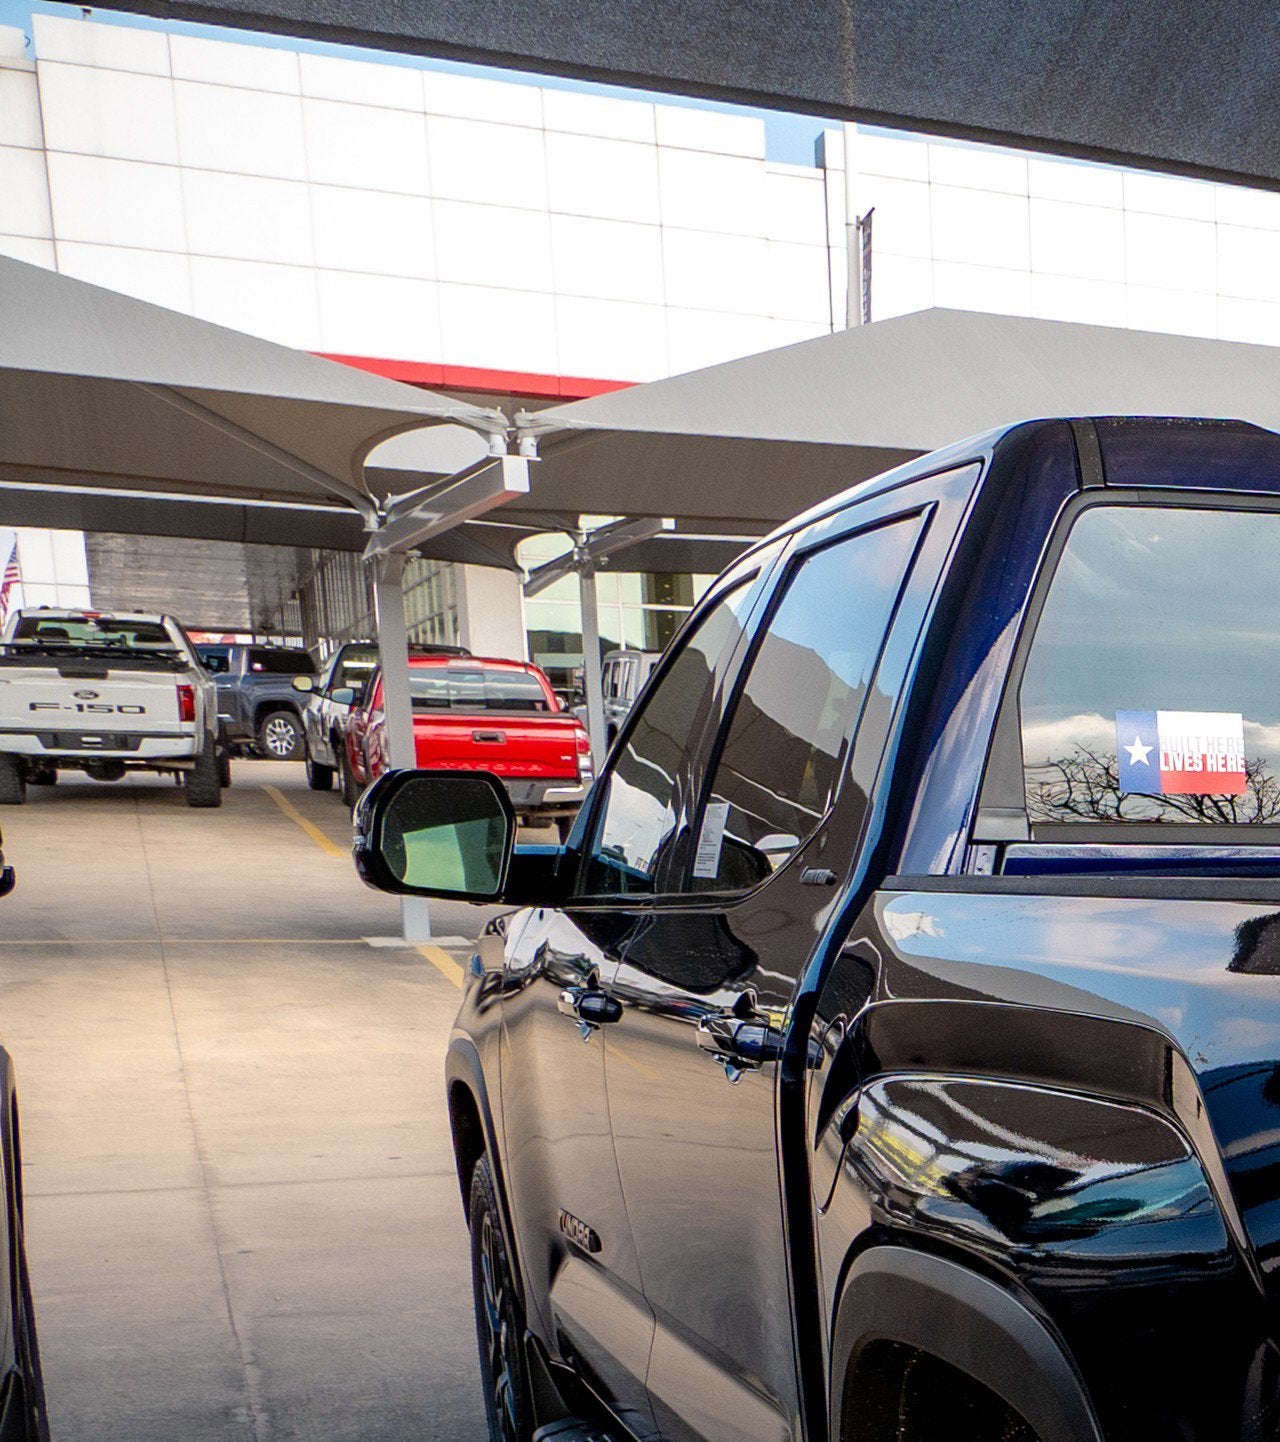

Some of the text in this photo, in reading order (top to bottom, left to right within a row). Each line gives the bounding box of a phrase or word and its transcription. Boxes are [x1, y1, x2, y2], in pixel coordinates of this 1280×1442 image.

[29, 702, 146, 714] F-150
[1161, 735, 1245, 754] BUILT HERE
[440, 762, 543, 772] TACOMA
[1160, 752, 1246, 773] LIVES HERE
